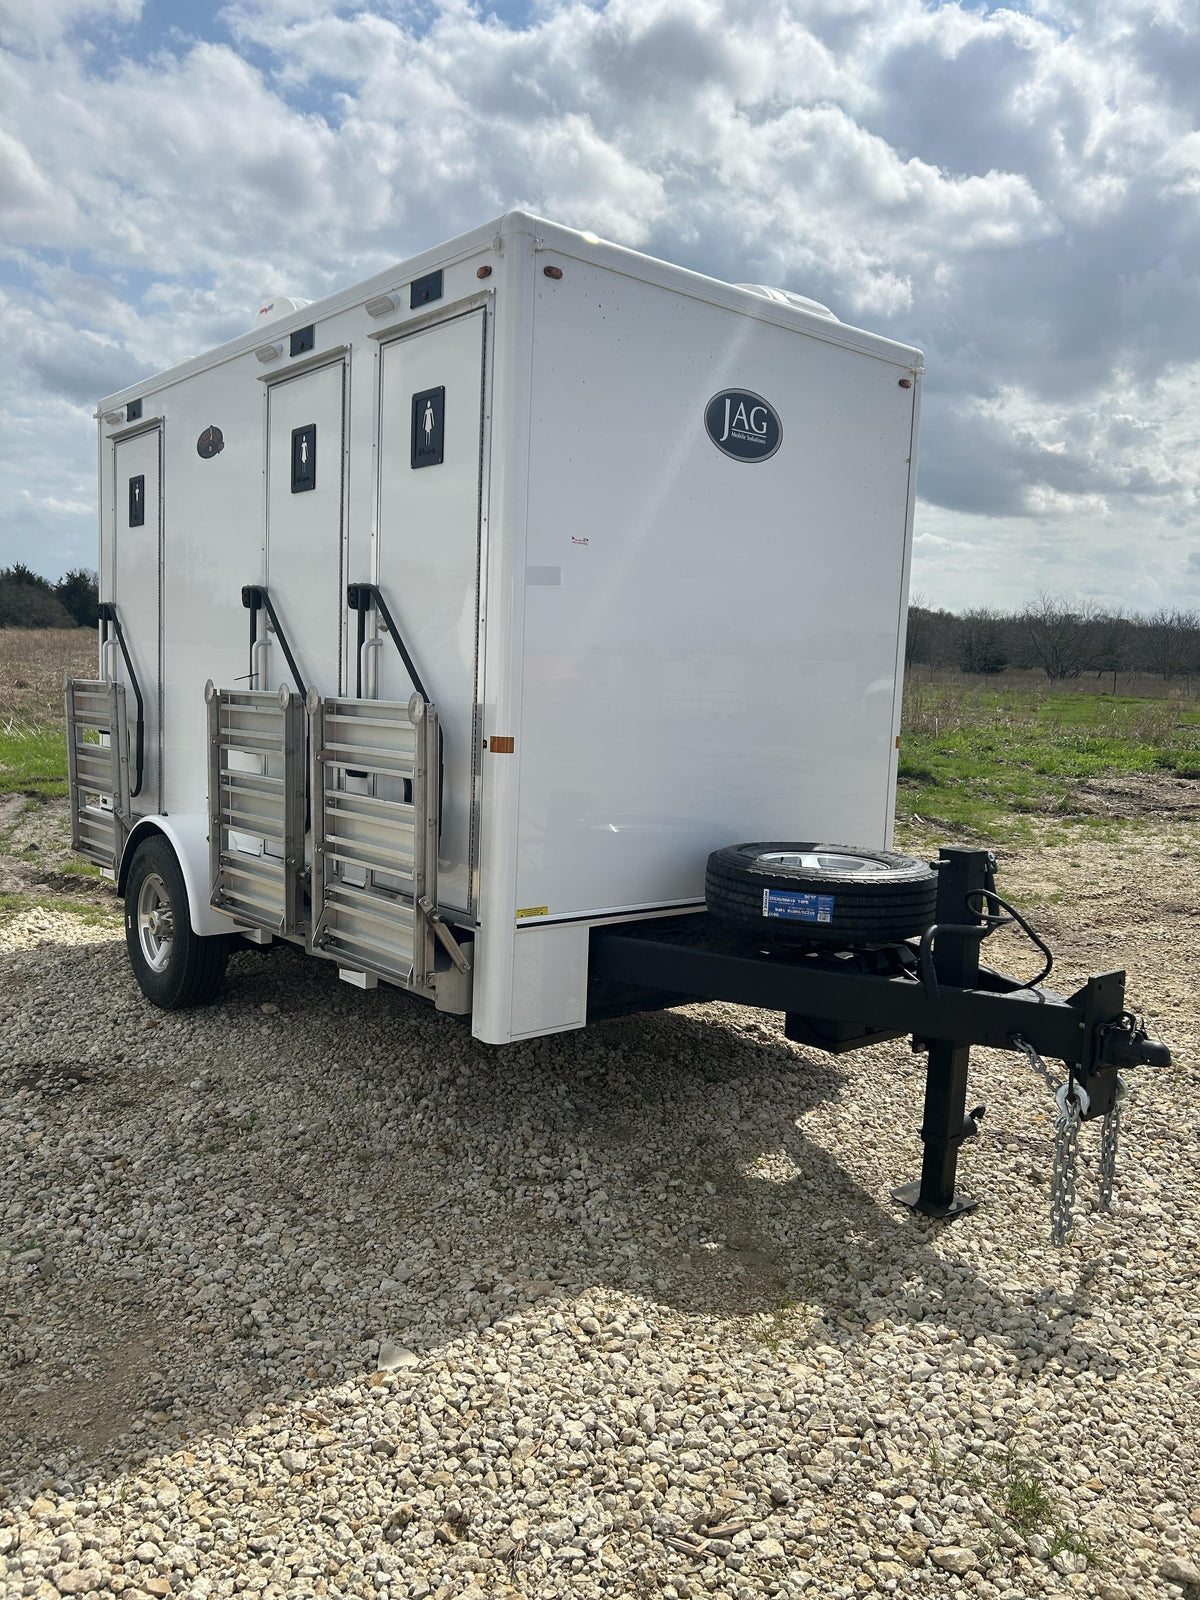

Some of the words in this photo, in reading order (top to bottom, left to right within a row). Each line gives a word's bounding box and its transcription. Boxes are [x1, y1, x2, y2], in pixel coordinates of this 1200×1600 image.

[720, 398, 767, 441] JAG
[731, 431, 746, 440] Mobile
[746, 435, 766, 444] Solutions
